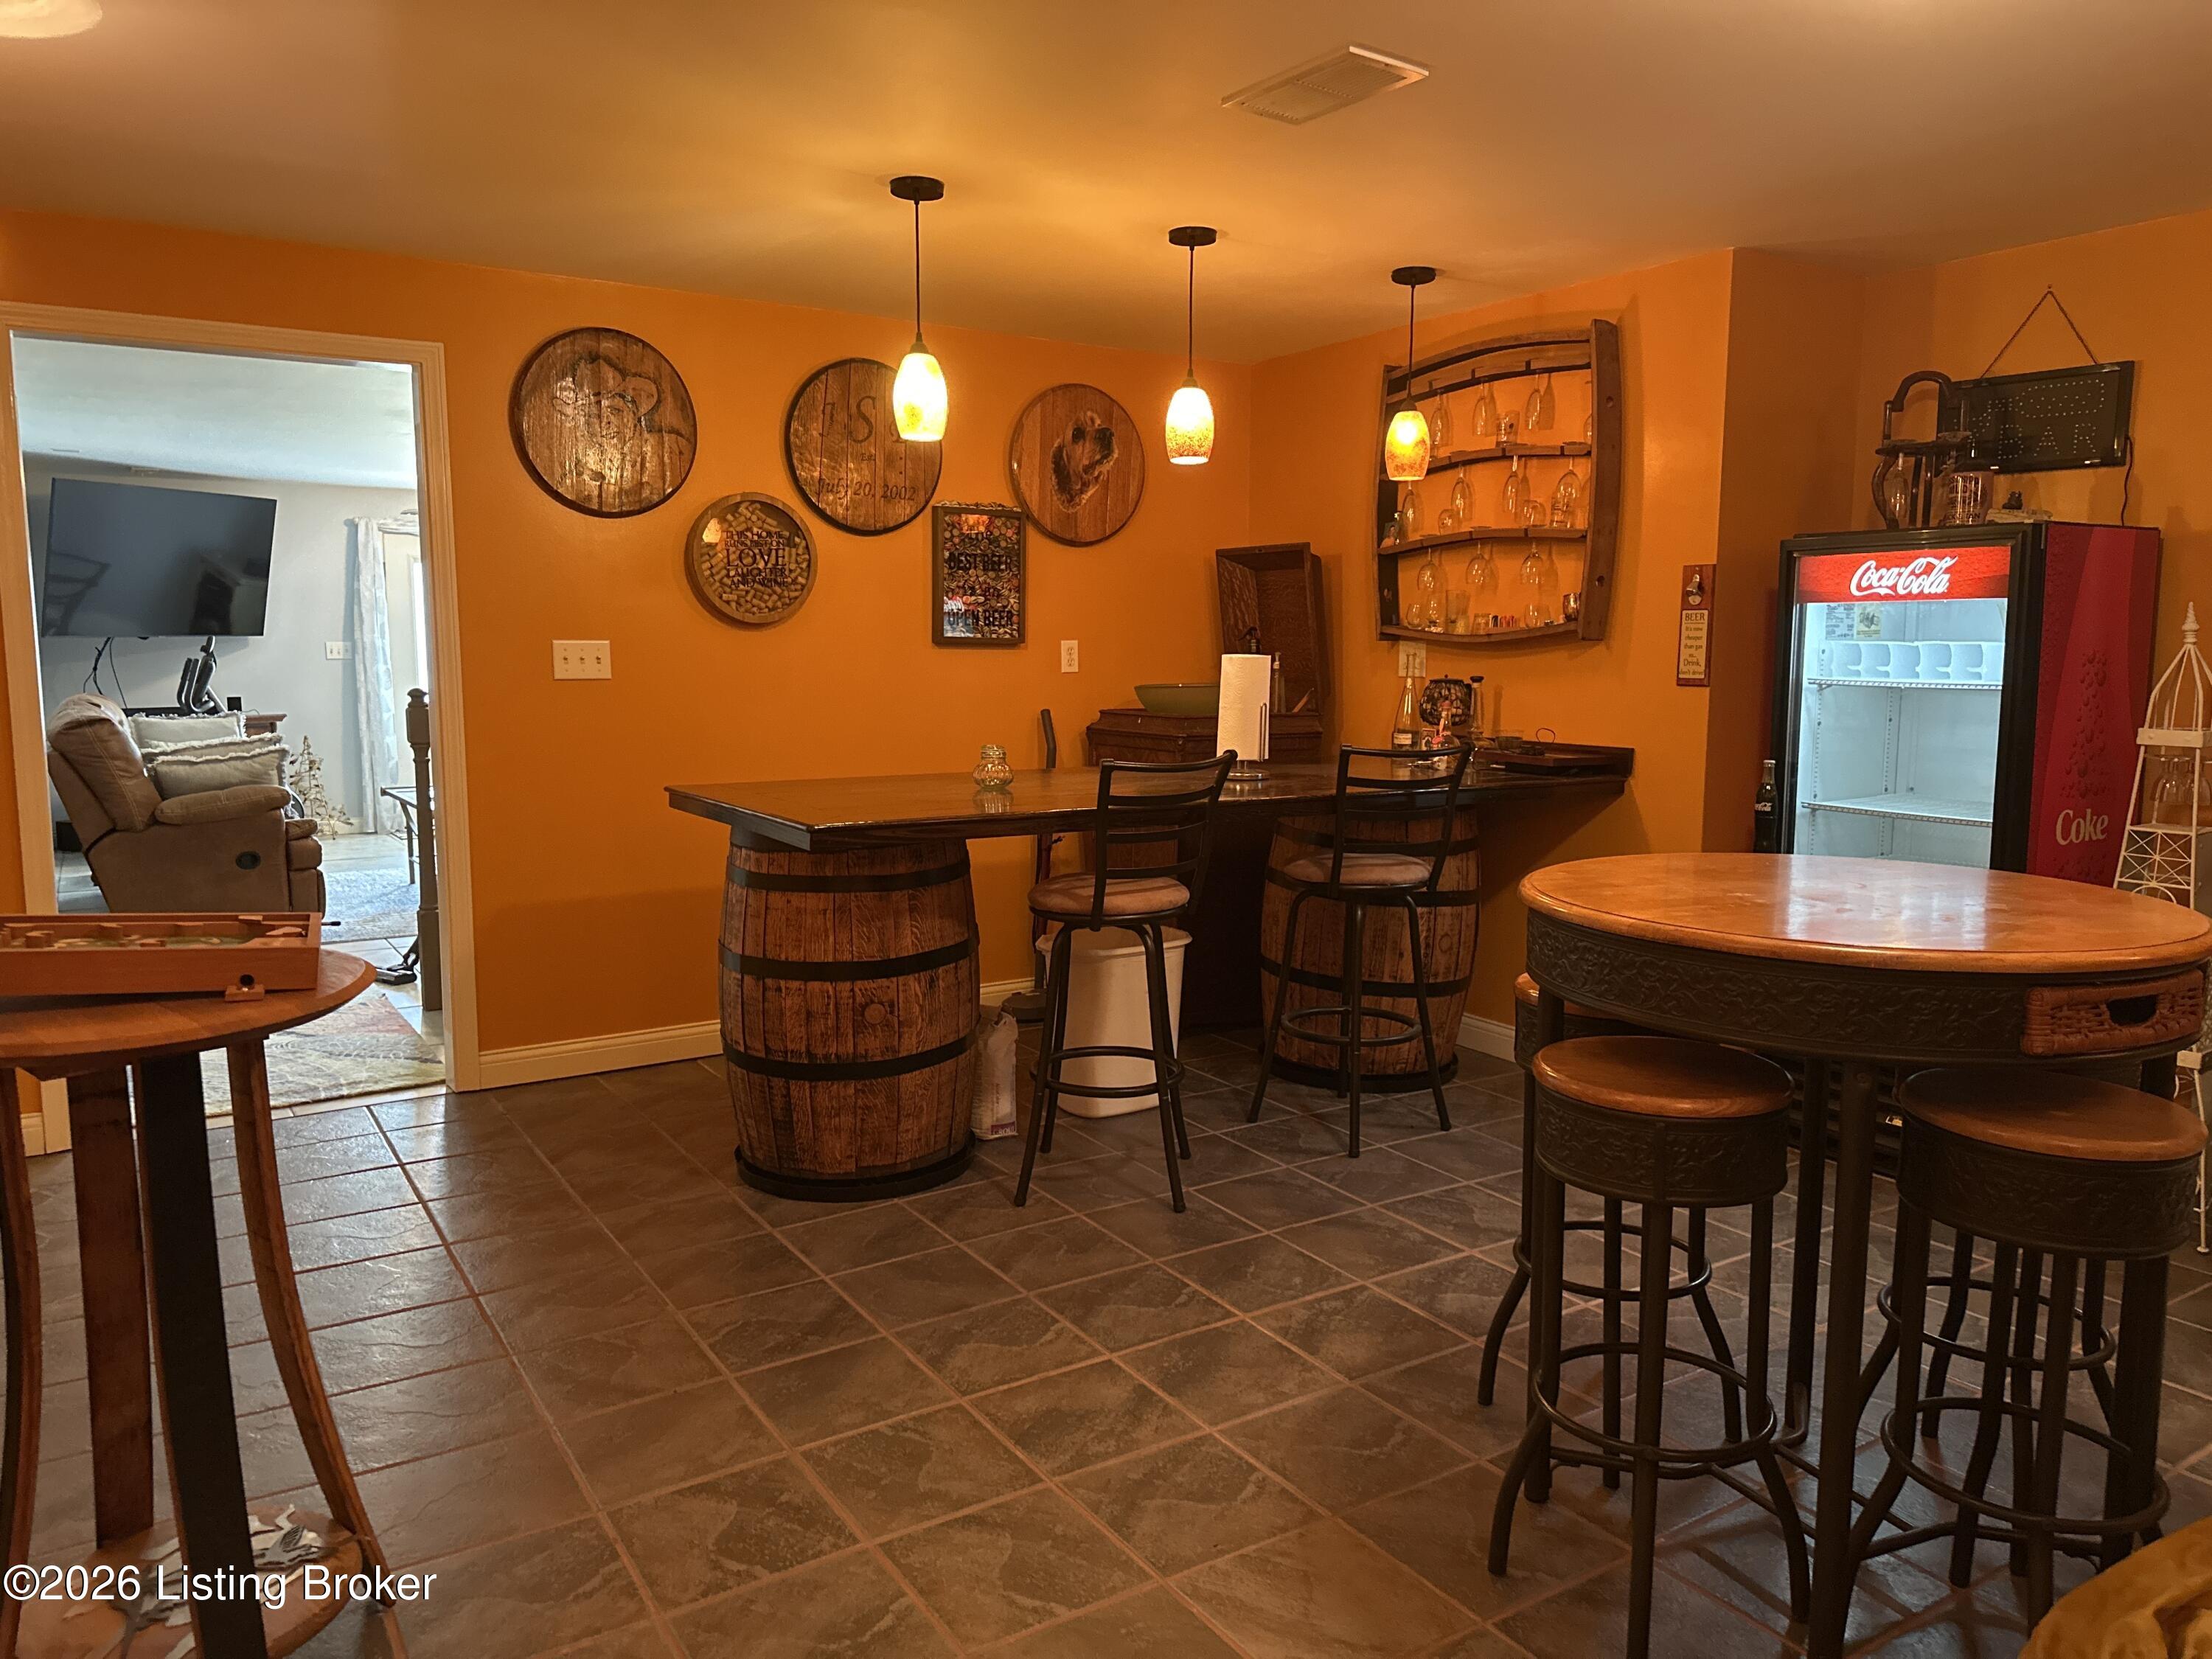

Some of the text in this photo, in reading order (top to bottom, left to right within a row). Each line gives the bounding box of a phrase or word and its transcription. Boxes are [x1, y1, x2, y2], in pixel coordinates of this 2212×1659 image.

[849, 396, 876, 442] S
[1997, 423, 2097, 459] BAR
[815, 477, 917, 501] July 20, 2002
[726, 530, 783, 539] THIS HOME
[771, 539, 785, 547] ON
[726, 548, 787, 567] LOVE
[948, 553, 1012, 571] BEST BEER
[726, 567, 787, 577] LAUGHTER
[1849, 554, 1958, 597] Coca-Cola
[730, 578, 788, 588] AND WINE
[948, 610, 1013, 627] OPEN BEER
[1685, 612, 1705, 622] BEER
[2056, 808, 2109, 846] Coke
